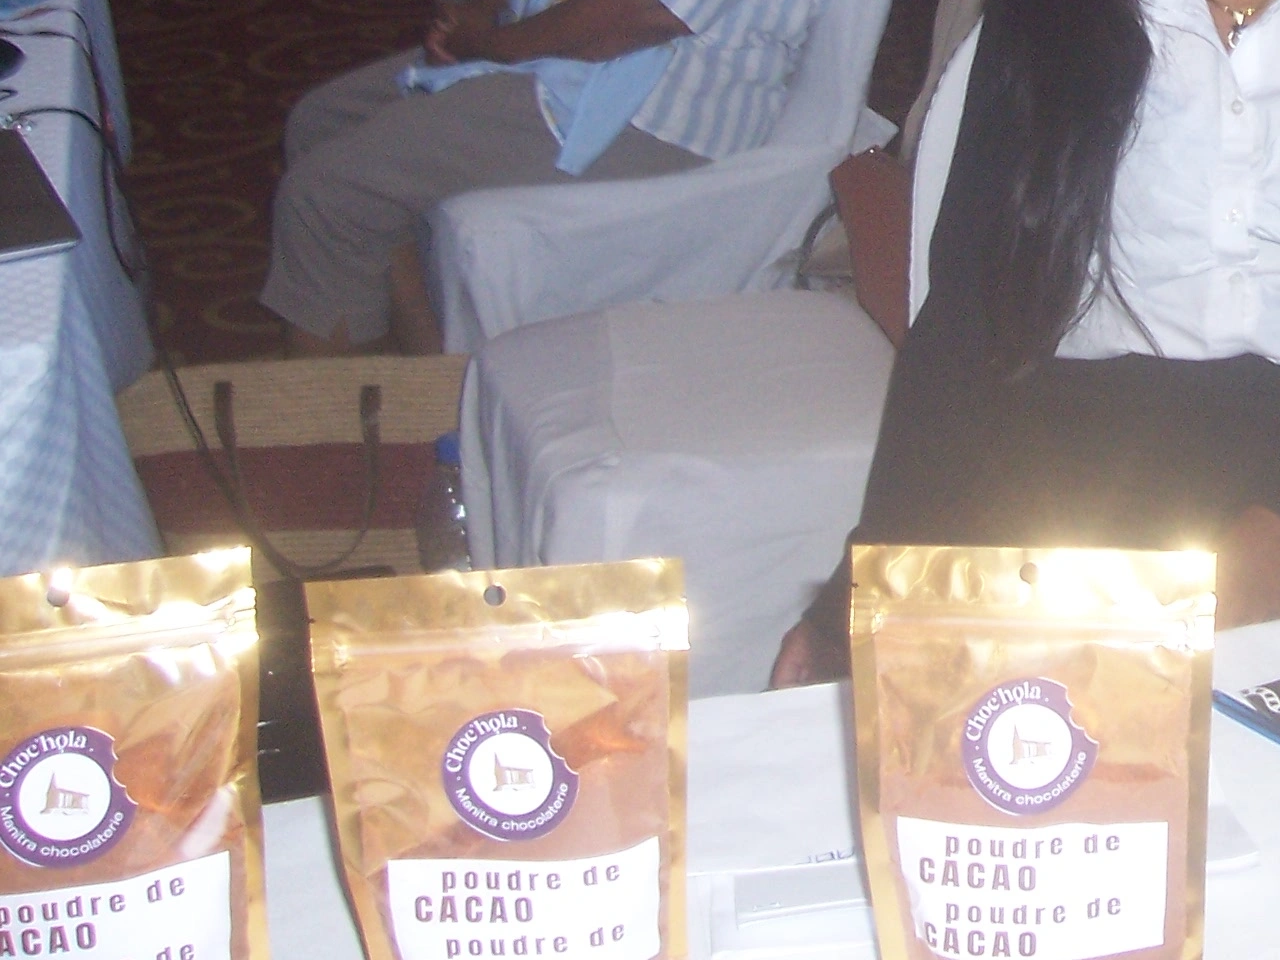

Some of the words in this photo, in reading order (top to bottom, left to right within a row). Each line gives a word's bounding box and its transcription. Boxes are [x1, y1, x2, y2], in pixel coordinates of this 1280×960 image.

[972, 757, 1013, 803] Manitra
[455, 787, 499, 828] Manitra
[0, 805, 38, 852] Manitra
[945, 835, 1063, 859] poudre
[1083, 833, 1121, 854] de
[146, 876, 186, 904] de
[441, 869, 561, 893] poudre
[582, 864, 620, 887] de
[918, 856, 1037, 892] CACAO
[414, 895, 534, 924] CACAO
[945, 902, 1067, 925] poudre
[1086, 897, 1122, 921] de
[0, 921, 97, 957] ACAO
[445, 935, 568, 960] poudre
[588, 923, 626, 948] de
[923, 921, 1037, 958] CACAO
